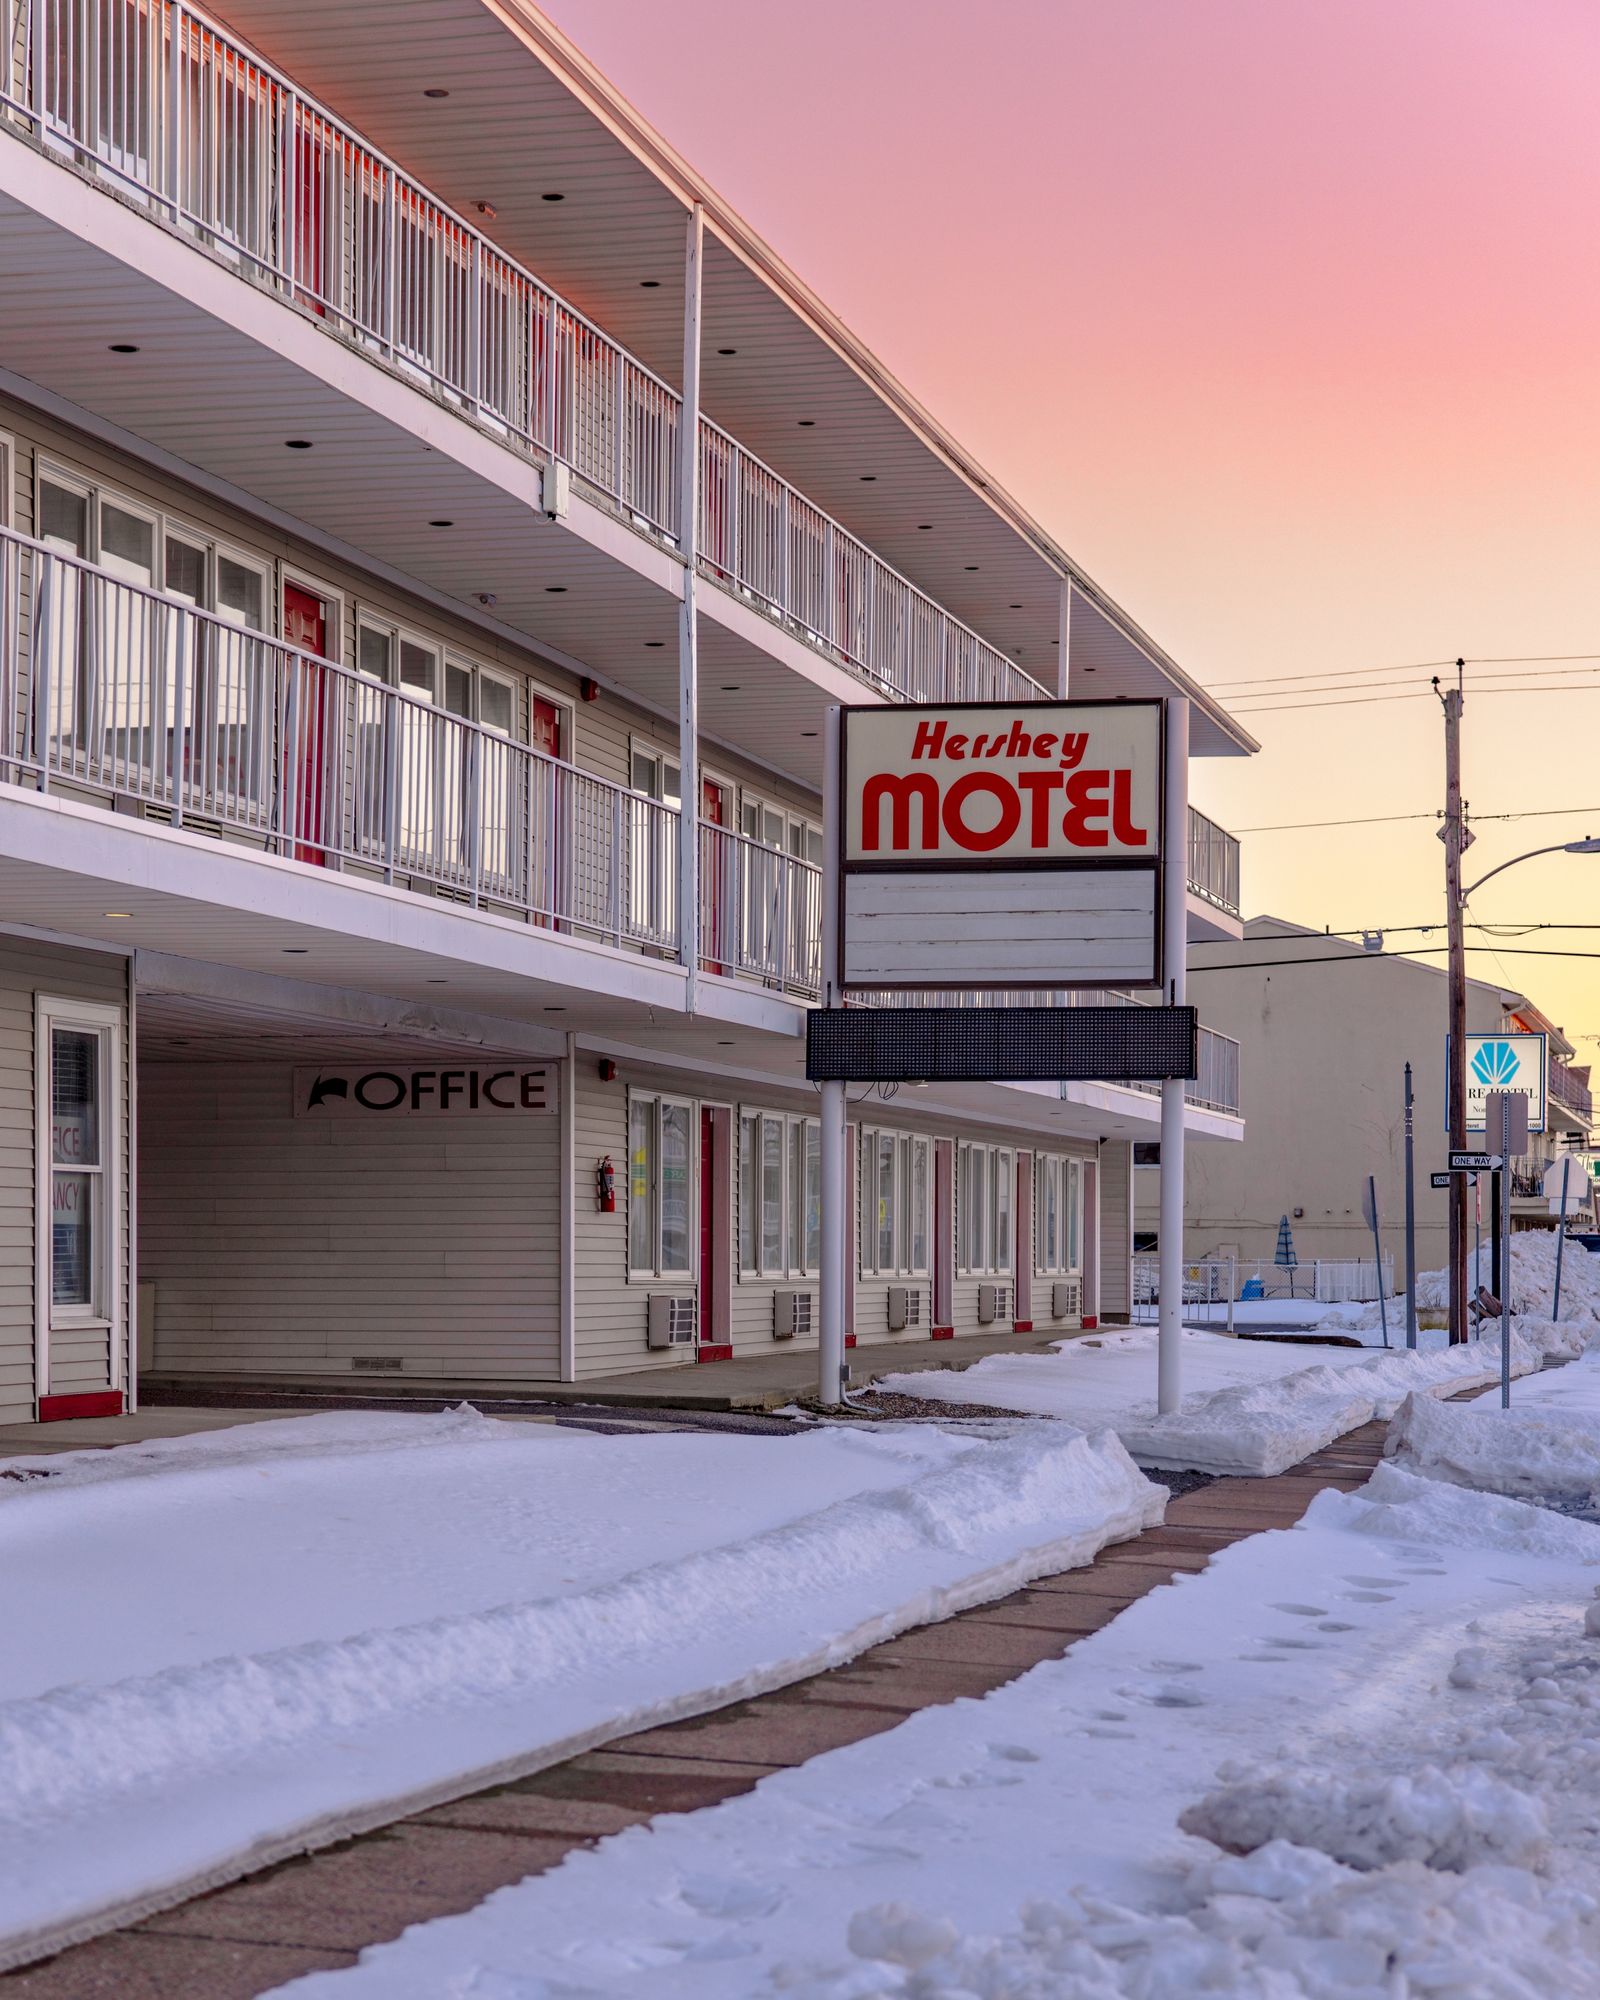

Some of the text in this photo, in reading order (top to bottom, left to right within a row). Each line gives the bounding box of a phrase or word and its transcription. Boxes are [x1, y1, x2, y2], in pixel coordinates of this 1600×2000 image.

[911, 720, 1089, 769] Hershey
[861, 769, 1147, 851] MOTEL
[354, 1070, 546, 1110] OFFICE
[1435, 1176, 1449, 1184] ONE
[1454, 1157, 1491, 1165] ONE WAY
